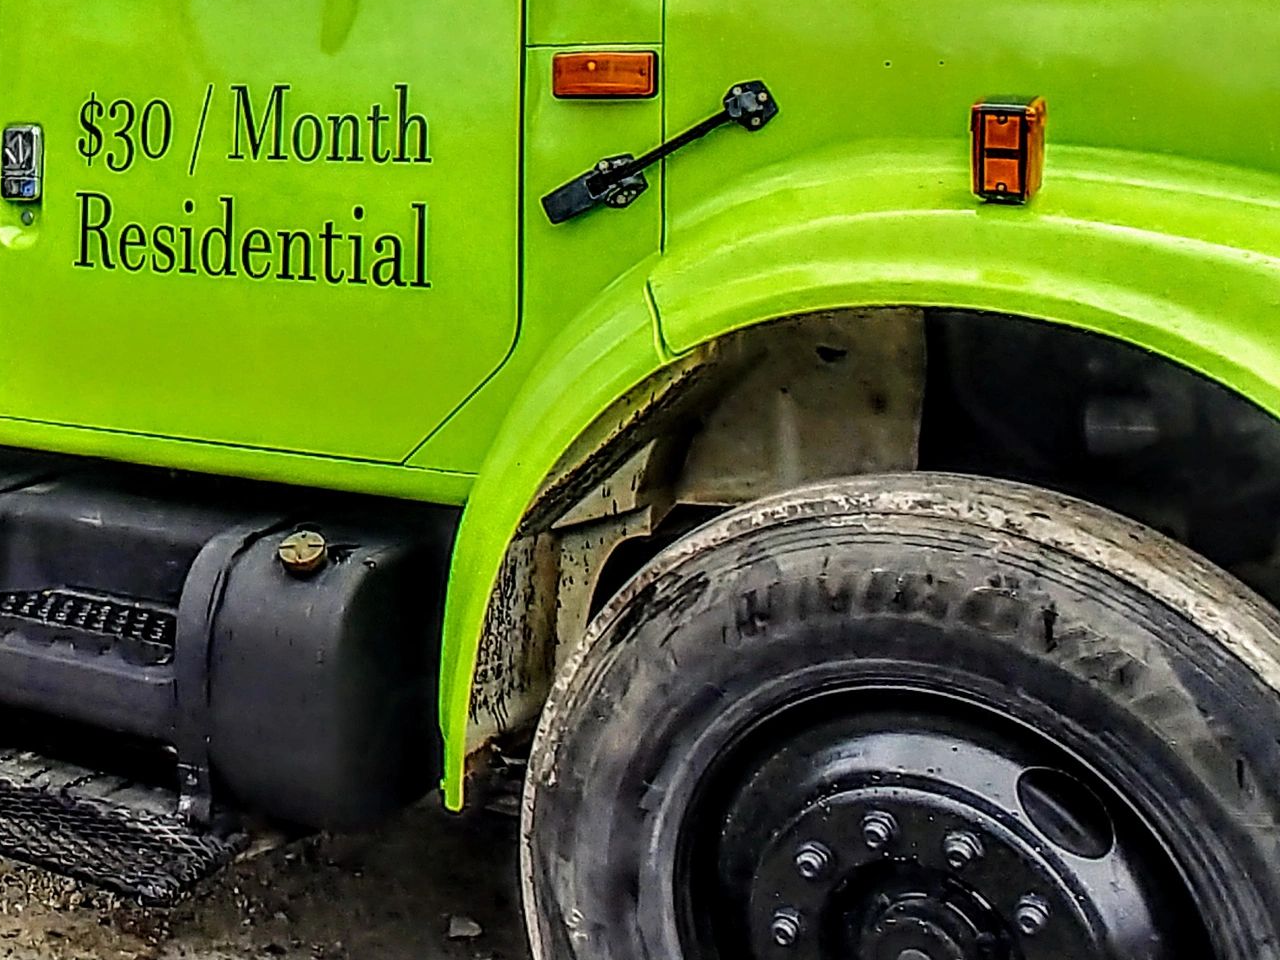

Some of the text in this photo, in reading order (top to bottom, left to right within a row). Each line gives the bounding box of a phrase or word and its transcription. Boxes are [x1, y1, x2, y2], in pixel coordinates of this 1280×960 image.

[77, 82, 433, 176] $30 / Month
[73, 192, 433, 289] Residential
